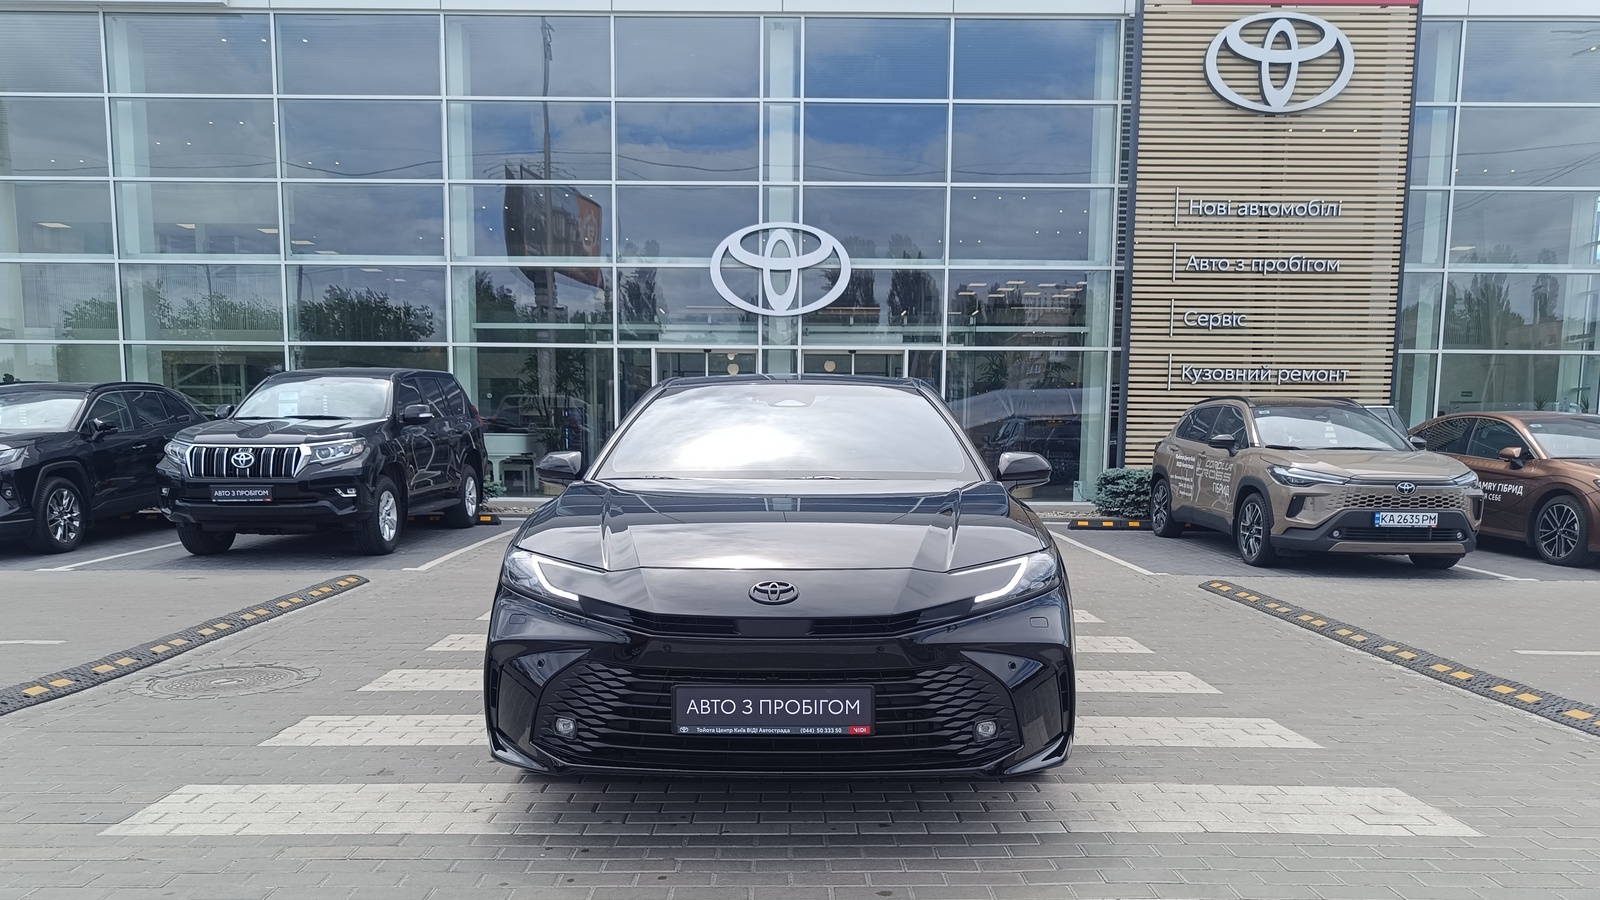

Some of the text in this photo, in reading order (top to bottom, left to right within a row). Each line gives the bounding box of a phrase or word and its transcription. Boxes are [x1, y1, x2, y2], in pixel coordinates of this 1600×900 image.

[1189, 199, 1343, 217] Нові автомобілі
[1185, 255, 1340, 276] Авто з пробігом
[1183, 310, 1247, 330] Сервіс
[1181, 364, 1350, 386] Кузовний ремонт
[1205, 459, 1233, 471] COROLLA
[1196, 467, 1231, 482] CROSS
[1479, 481, 1524, 496] AMRY ГІБРИД
[1488, 493, 1502, 502] СЕБЕ
[1397, 514, 1420, 524] 2635
[686, 699, 860, 715] АВТО З ПРОБІГОМ
